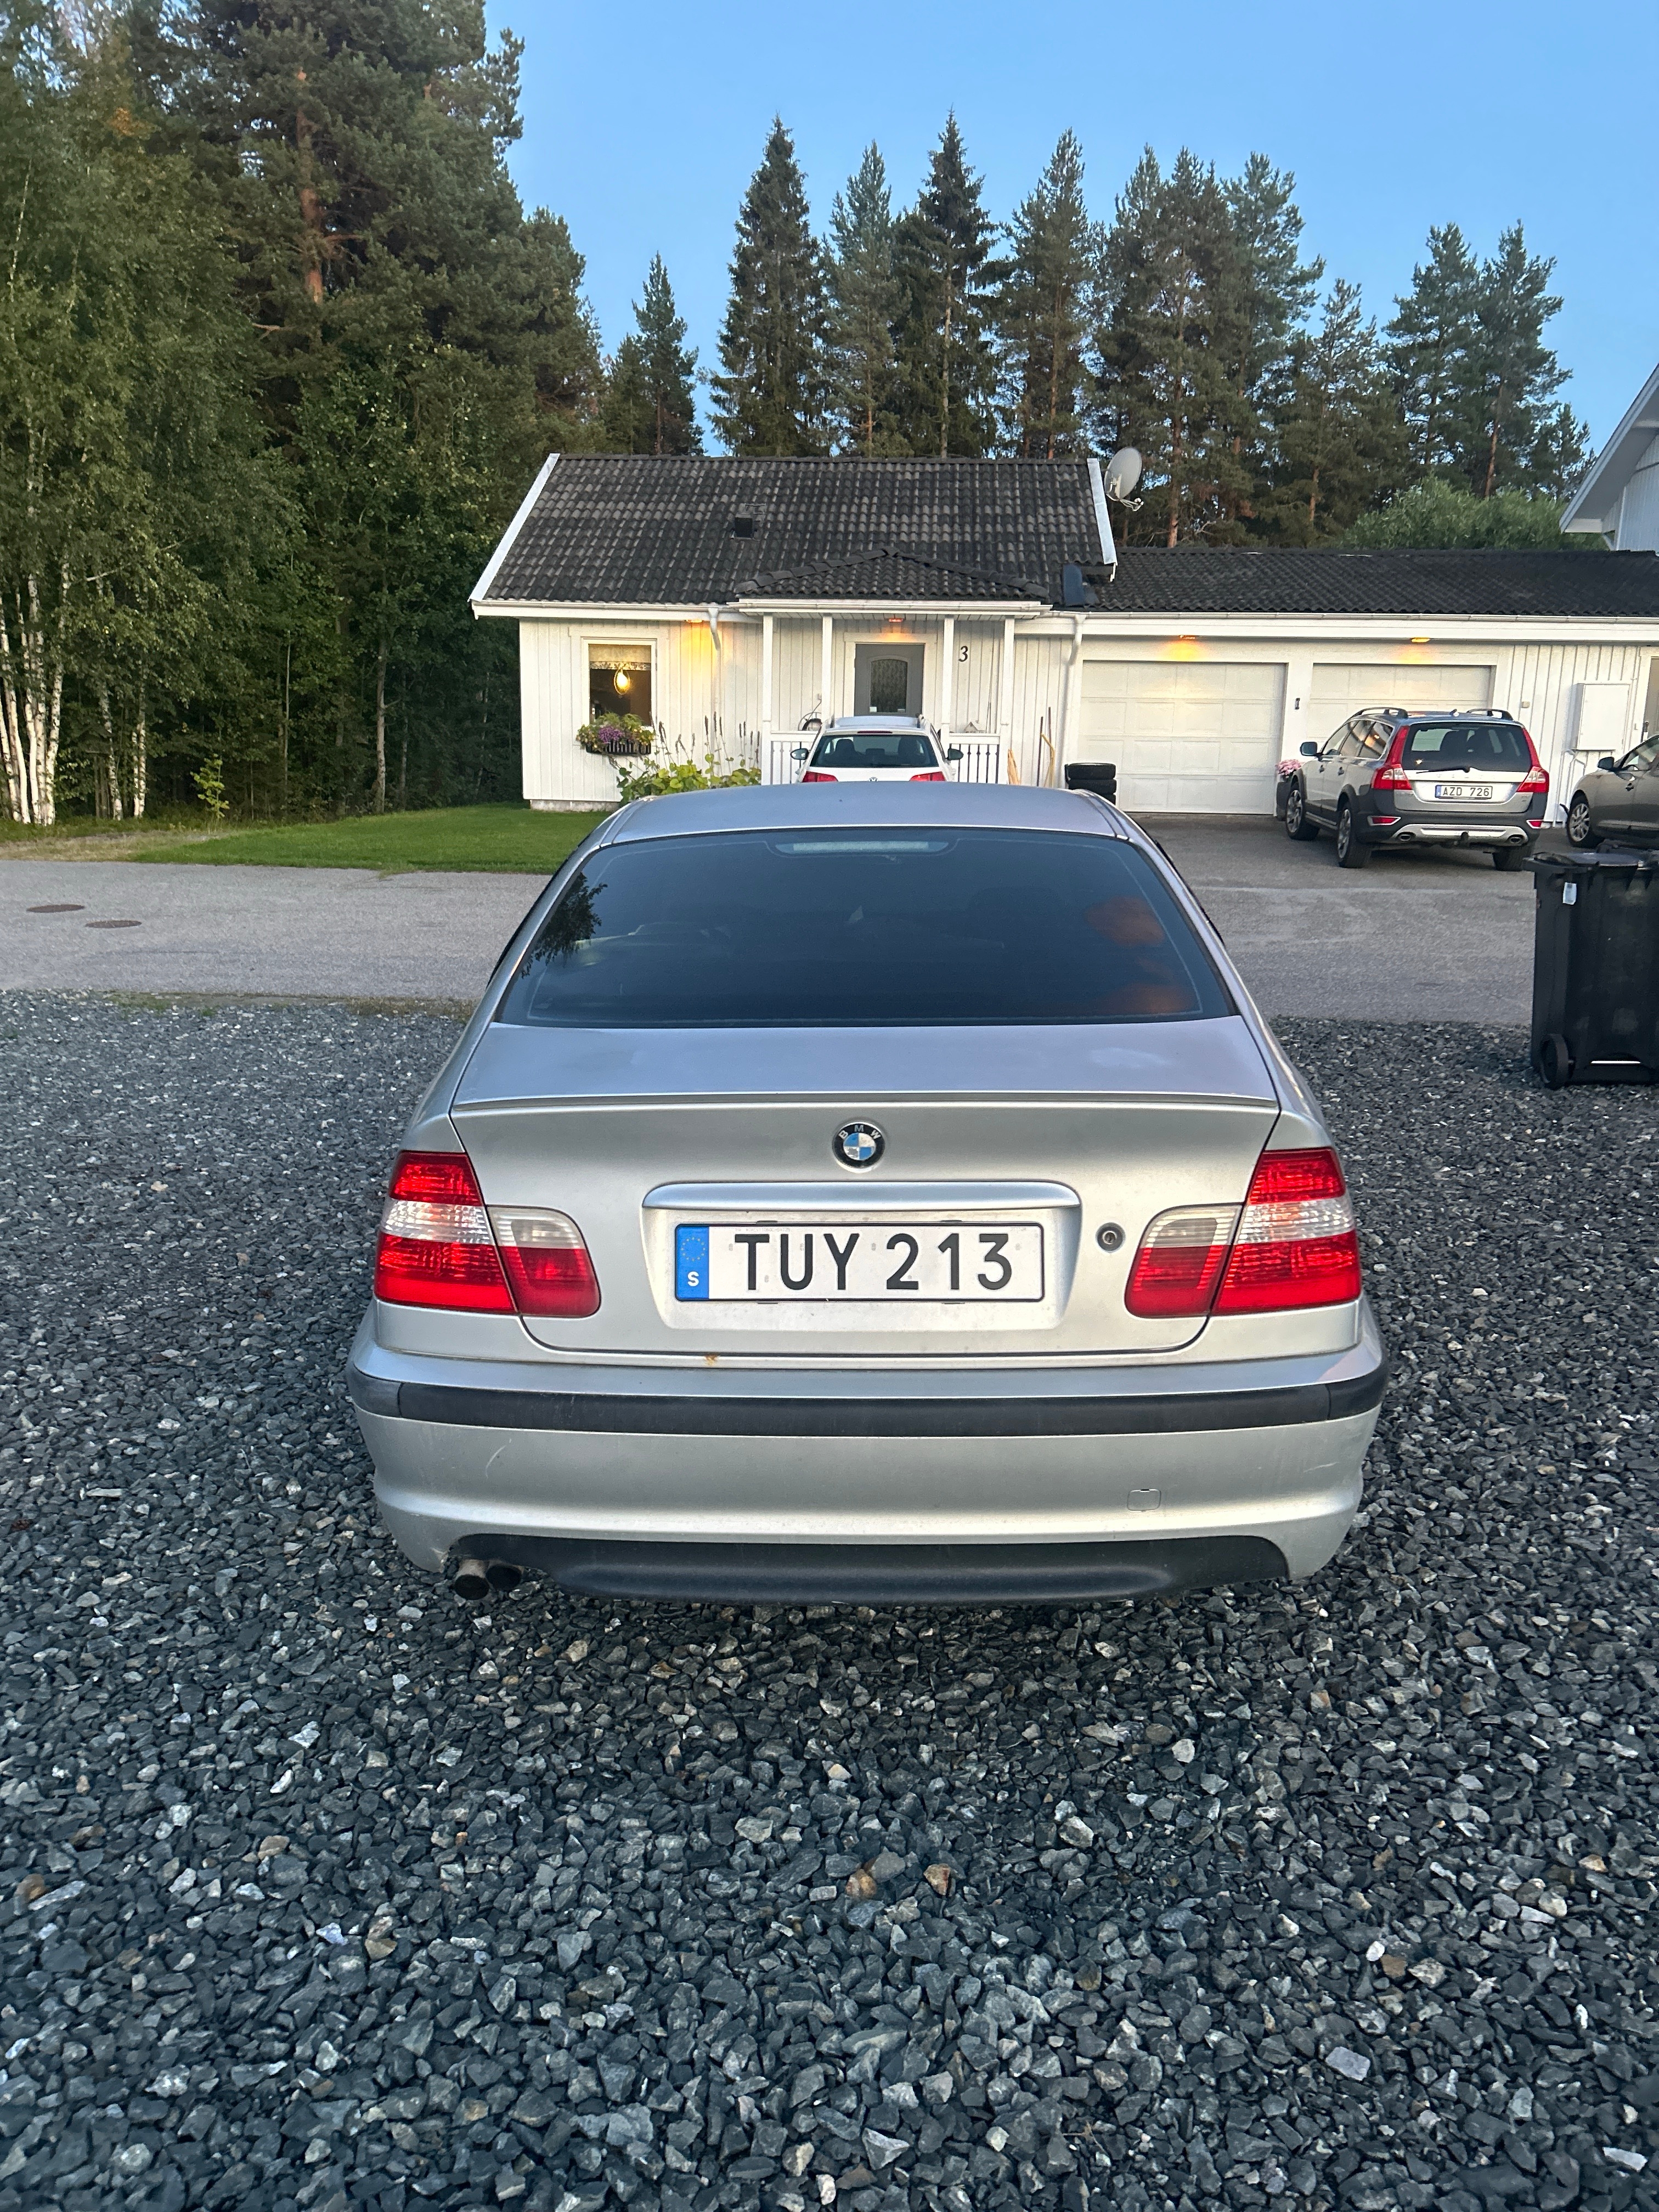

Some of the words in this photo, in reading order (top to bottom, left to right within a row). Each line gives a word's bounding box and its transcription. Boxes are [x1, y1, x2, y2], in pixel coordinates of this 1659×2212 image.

[958, 645, 968, 662] 3
[1442, 787, 1463, 796] AZD
[1470, 787, 1489, 797] 726
[838, 1125, 881, 1139] BMW
[735, 1233, 860, 1290] TUY
[886, 1233, 1012, 1290] 213
[687, 1271, 699, 1286] S
